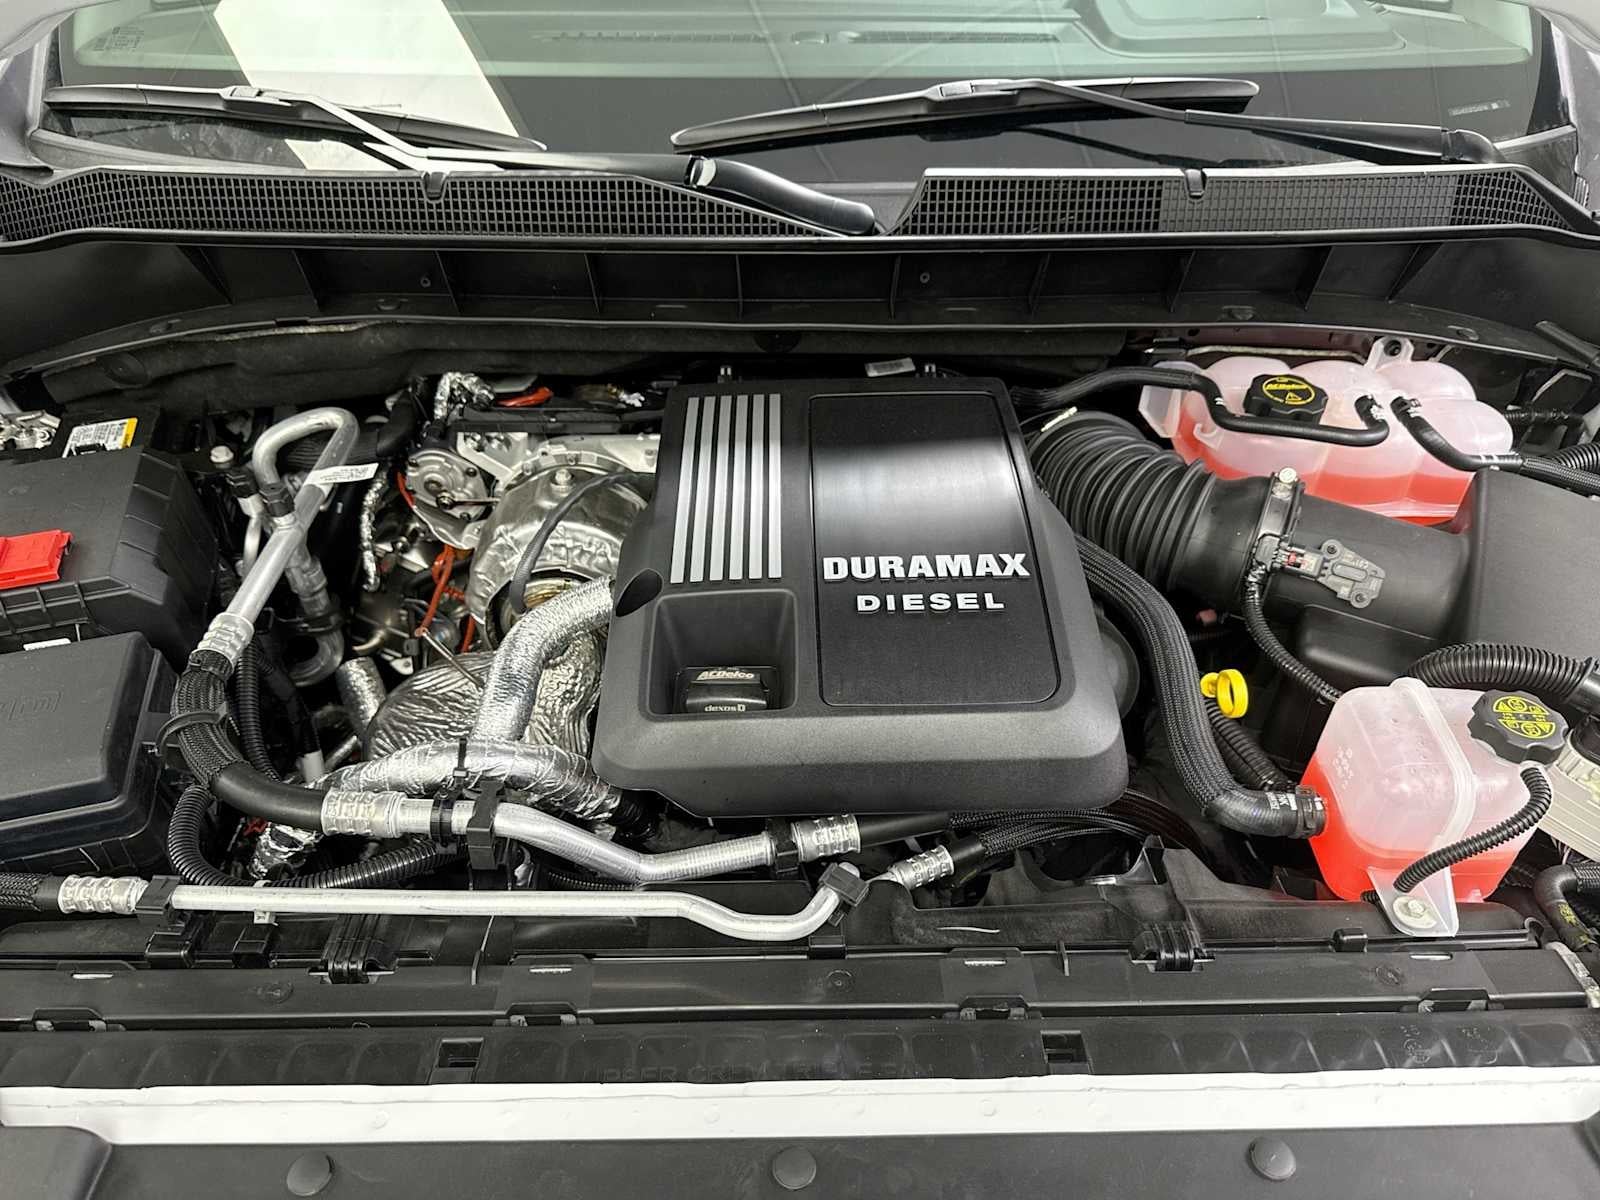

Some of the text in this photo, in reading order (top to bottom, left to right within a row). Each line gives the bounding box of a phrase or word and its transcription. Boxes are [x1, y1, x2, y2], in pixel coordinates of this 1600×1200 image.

[823, 554, 1031, 581] DURAMAX
[857, 593, 1005, 612] DIESEL
[696, 670, 755, 681] ACDelco
